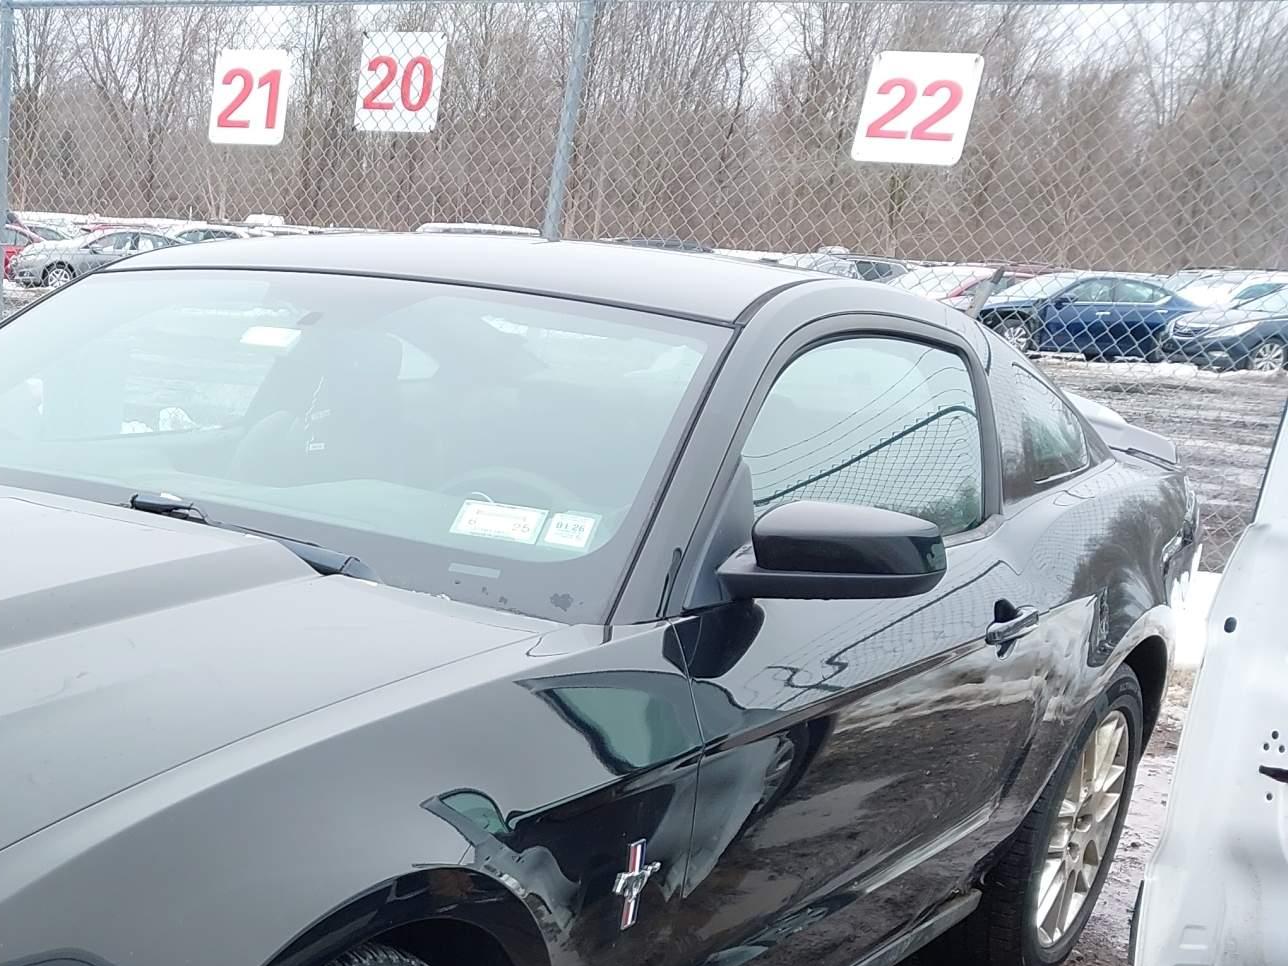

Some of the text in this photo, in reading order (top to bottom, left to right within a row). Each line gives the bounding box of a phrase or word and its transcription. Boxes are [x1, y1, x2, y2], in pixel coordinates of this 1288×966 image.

[218, 67, 281, 129] 21
[363, 55, 433, 112] 20
[865, 78, 963, 141] 22
